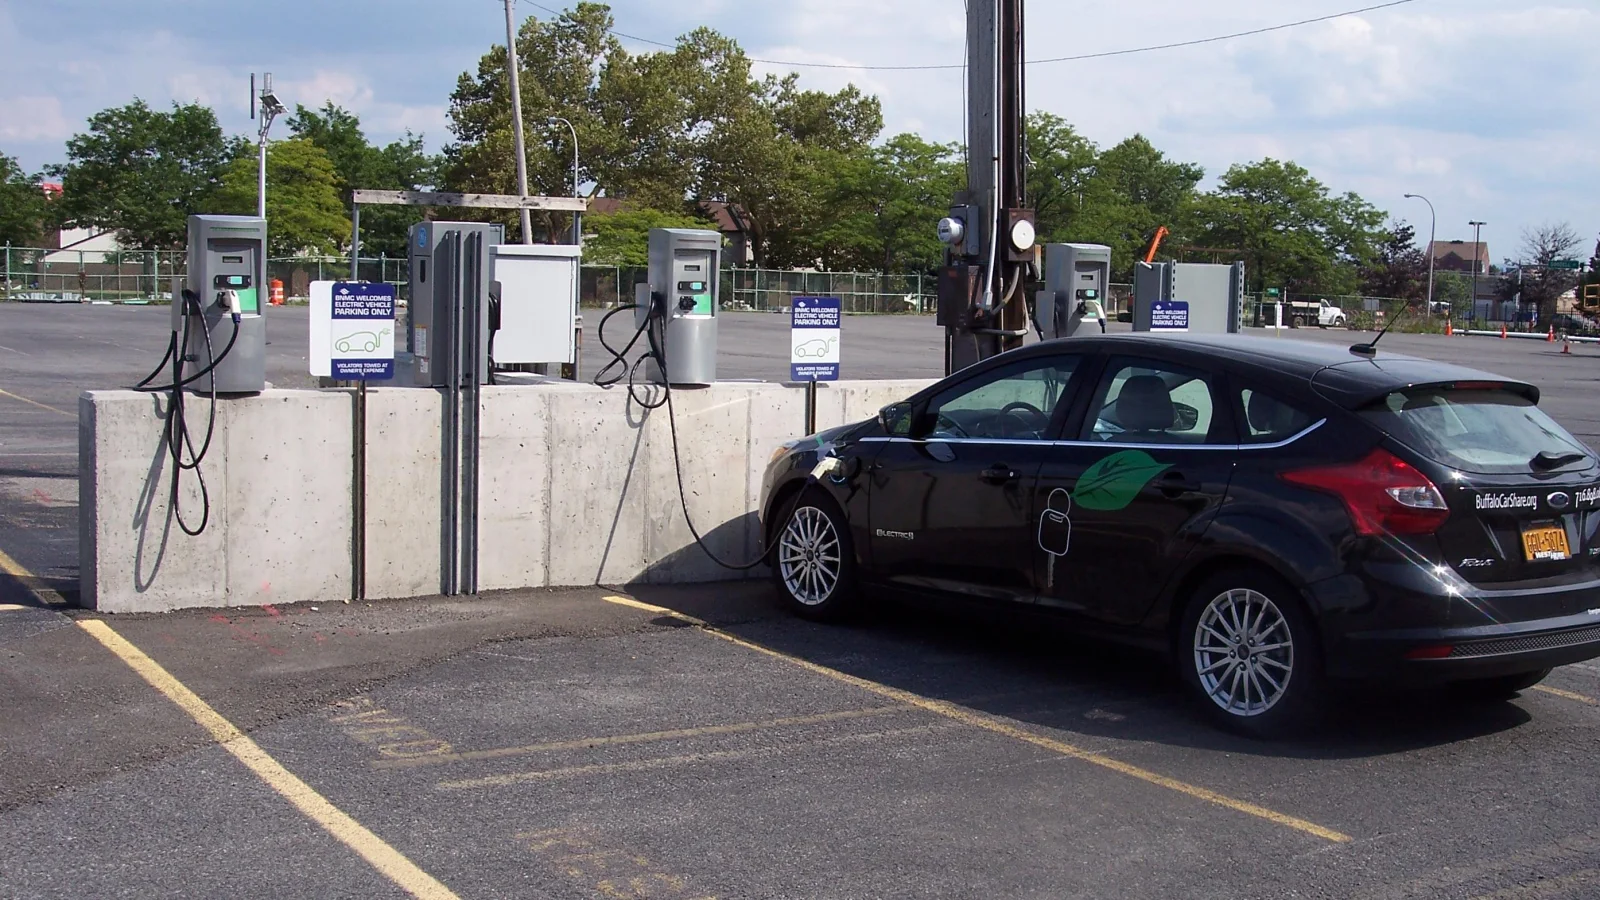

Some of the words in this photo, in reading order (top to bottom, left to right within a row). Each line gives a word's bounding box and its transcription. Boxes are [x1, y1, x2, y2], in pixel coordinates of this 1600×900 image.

[371, 308, 392, 316] ONLY
[1476, 493, 1537, 510] BuffaloCarShare.org
[1535, 551, 1551, 559] WEST
